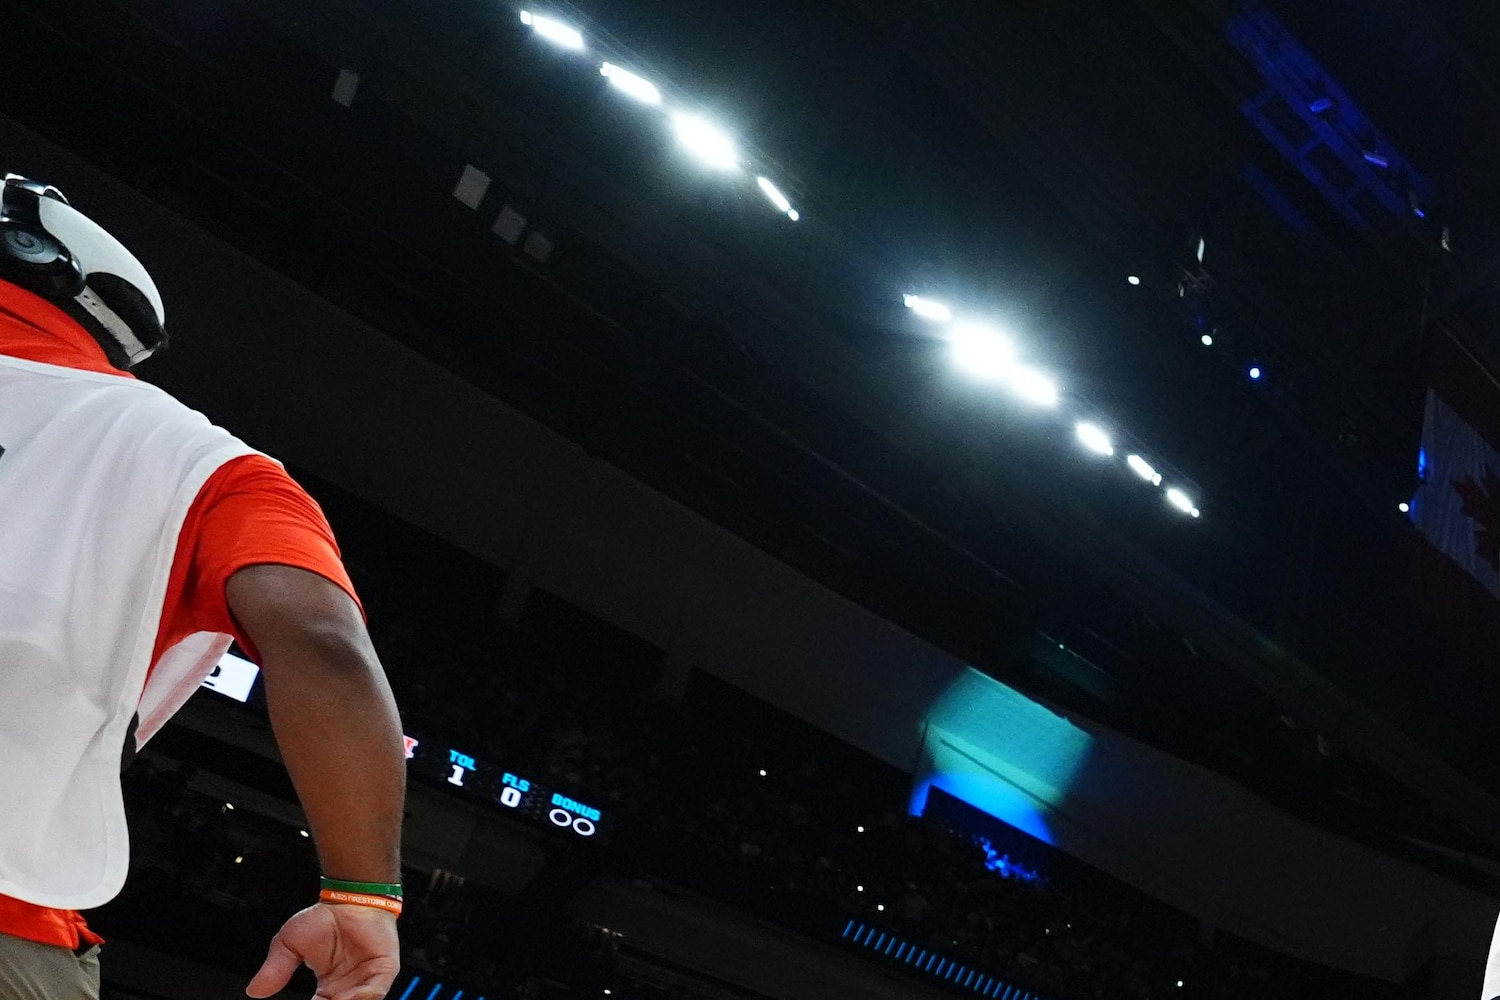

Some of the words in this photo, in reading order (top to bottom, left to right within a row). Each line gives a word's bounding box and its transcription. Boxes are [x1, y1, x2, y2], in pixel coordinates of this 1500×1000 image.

[449, 750, 476, 771] TOL
[448, 764, 464, 787] 1
[502, 773, 530, 792] FLS
[500, 786, 521, 808] 0
[552, 793, 601, 821] BONUS
